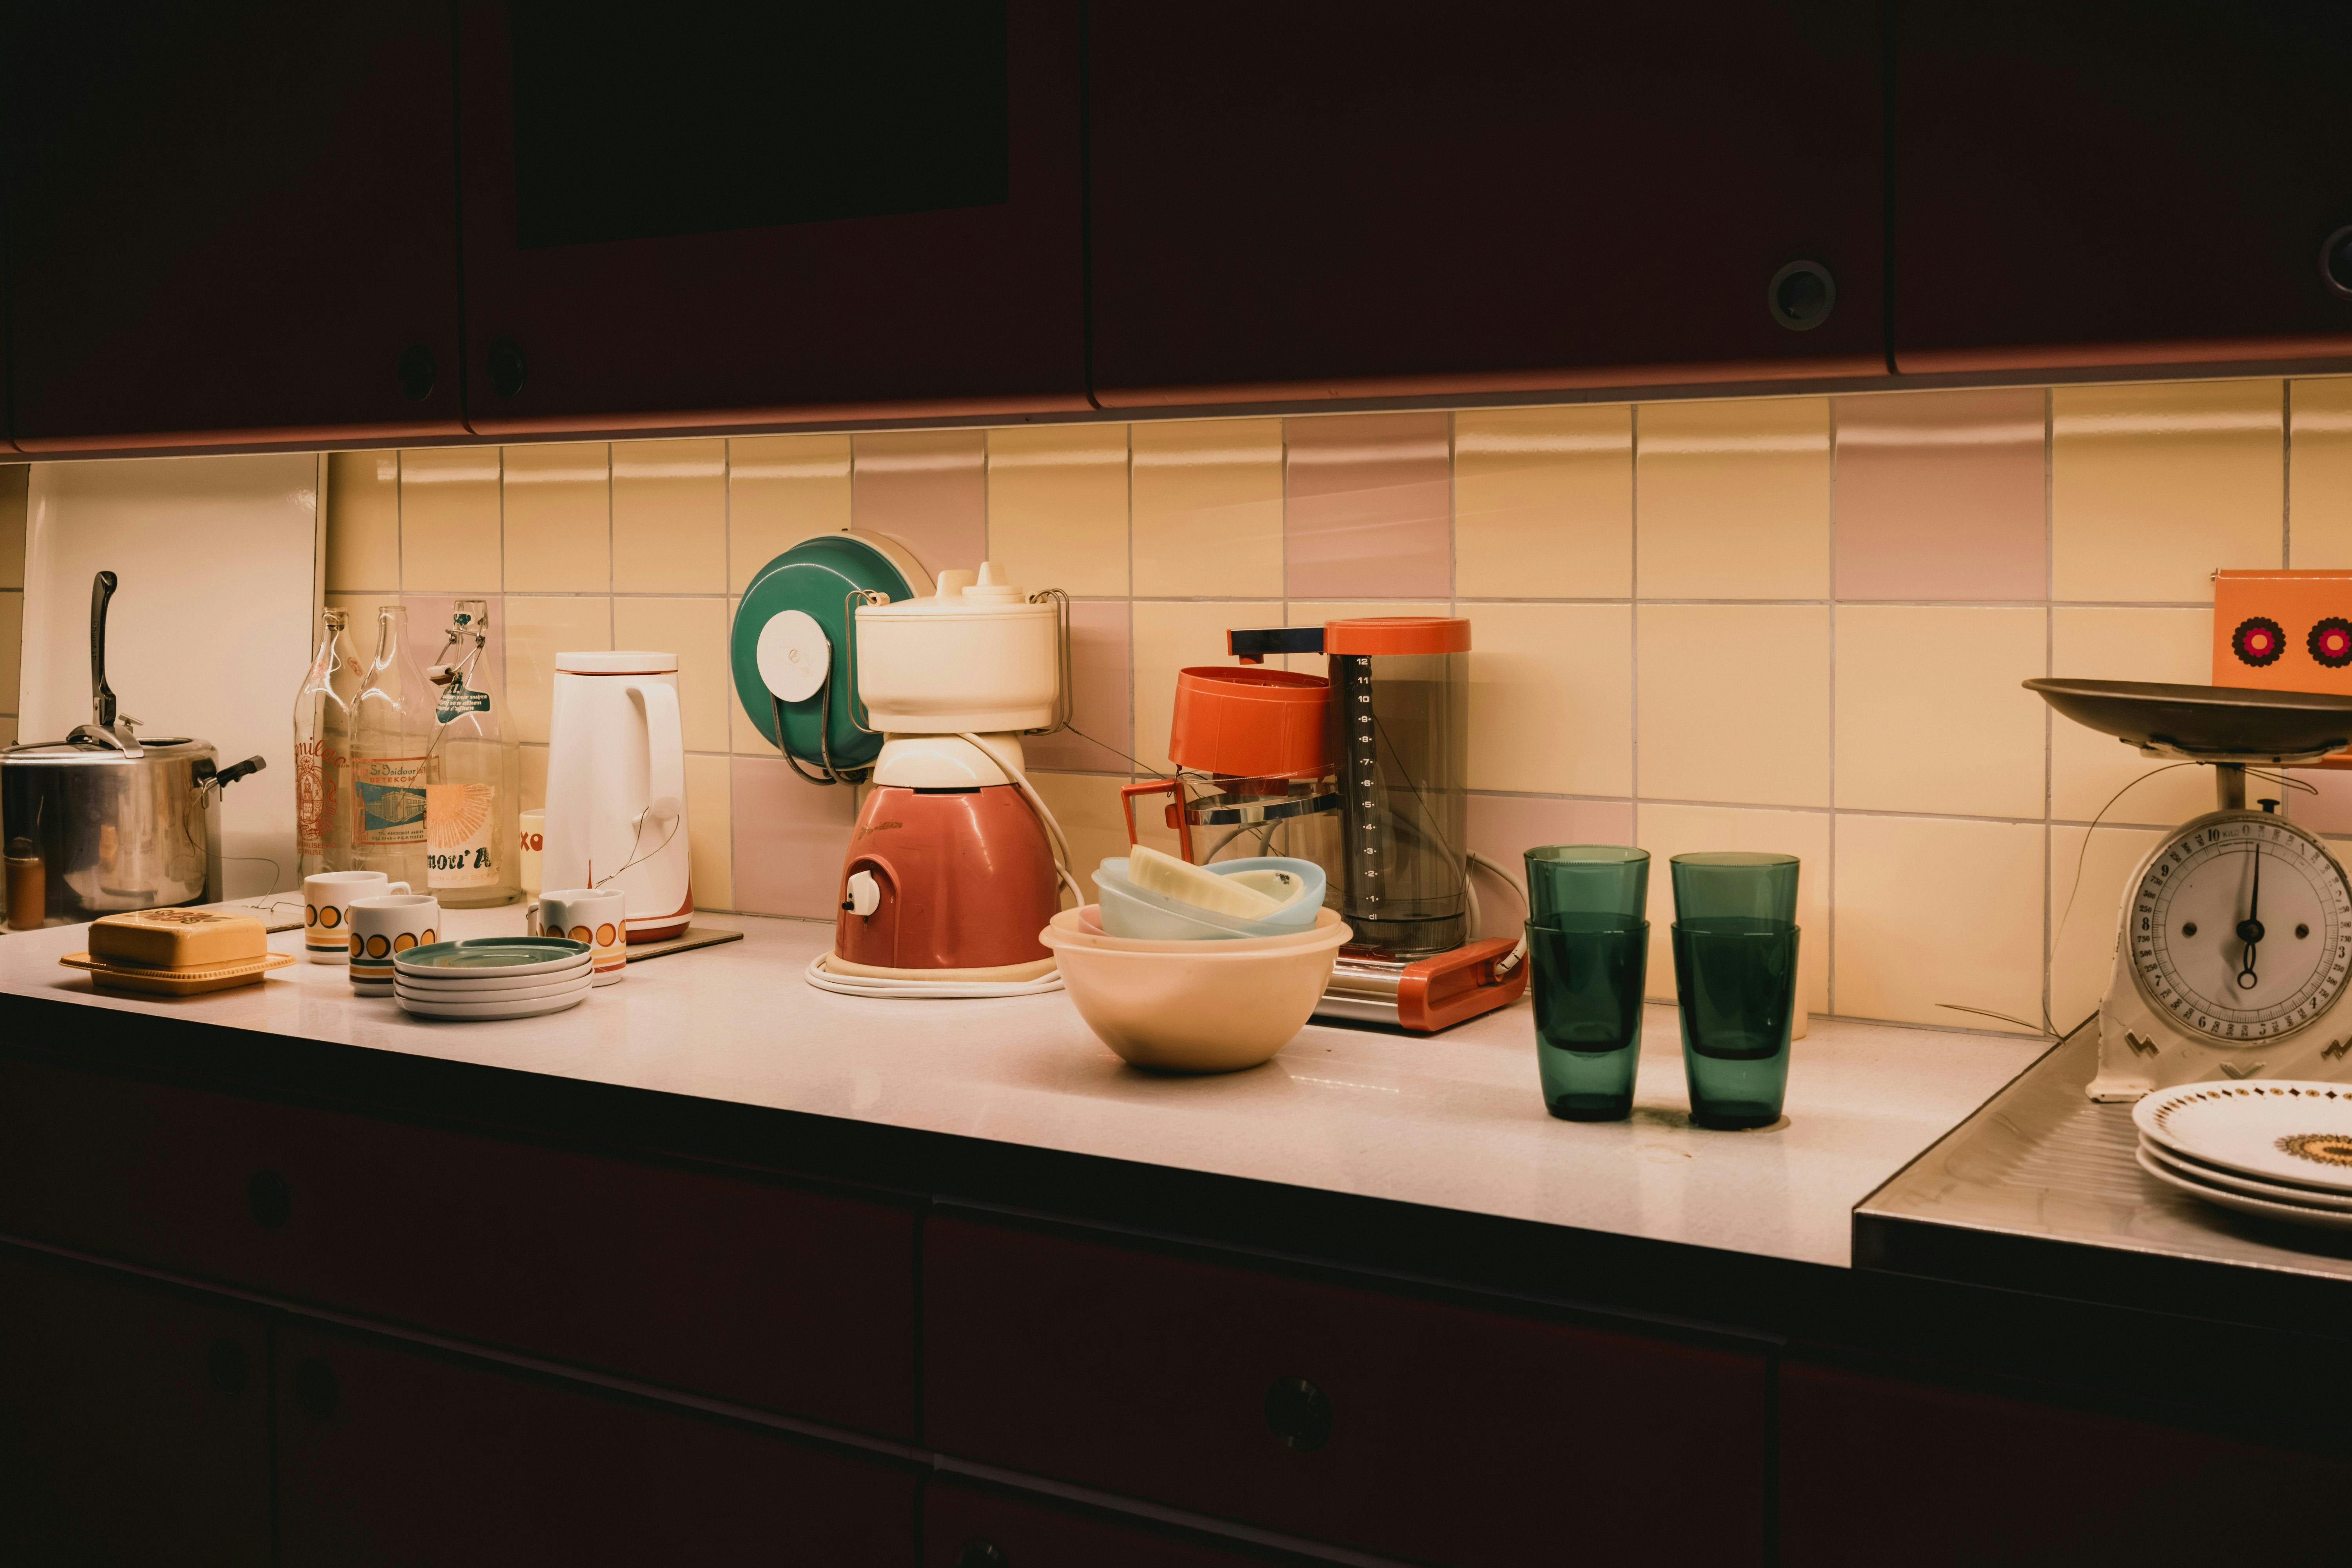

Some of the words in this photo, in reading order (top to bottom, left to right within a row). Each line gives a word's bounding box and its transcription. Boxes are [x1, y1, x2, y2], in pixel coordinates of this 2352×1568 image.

[2208, 828, 2220, 842] 10
[2242, 824, 2250, 836] 0
[2195, 834, 2205, 847] 750
[2170, 851, 2182, 863] 250
[2161, 864, 2169, 877] 9
[2150, 875, 2163, 886] 750
[2143, 890, 2156, 899] 500
[2139, 904, 2152, 913] 250
[2141, 917, 2150, 931] 8
[2139, 949, 2152, 958] 500
[2338, 946, 2345, 959] 3
[2144, 963, 2158, 973] 250
[2332, 964, 2345, 973] 250
[2155, 975, 2162, 987] 7
[2326, 976, 2337, 986] 500
[2160, 988, 2172, 999] 750
[2318, 988, 2329, 999] 750
[2170, 998, 2183, 1010] 500
[2309, 996, 2317, 1009] 4
[2183, 1008, 2194, 1020] 250
[2198, 1016, 2206, 1028] 6
[2211, 1021, 2220, 1033] 750
[2225, 1024, 2234, 1036] 500
[2259, 1023, 2267, 1035] 5
